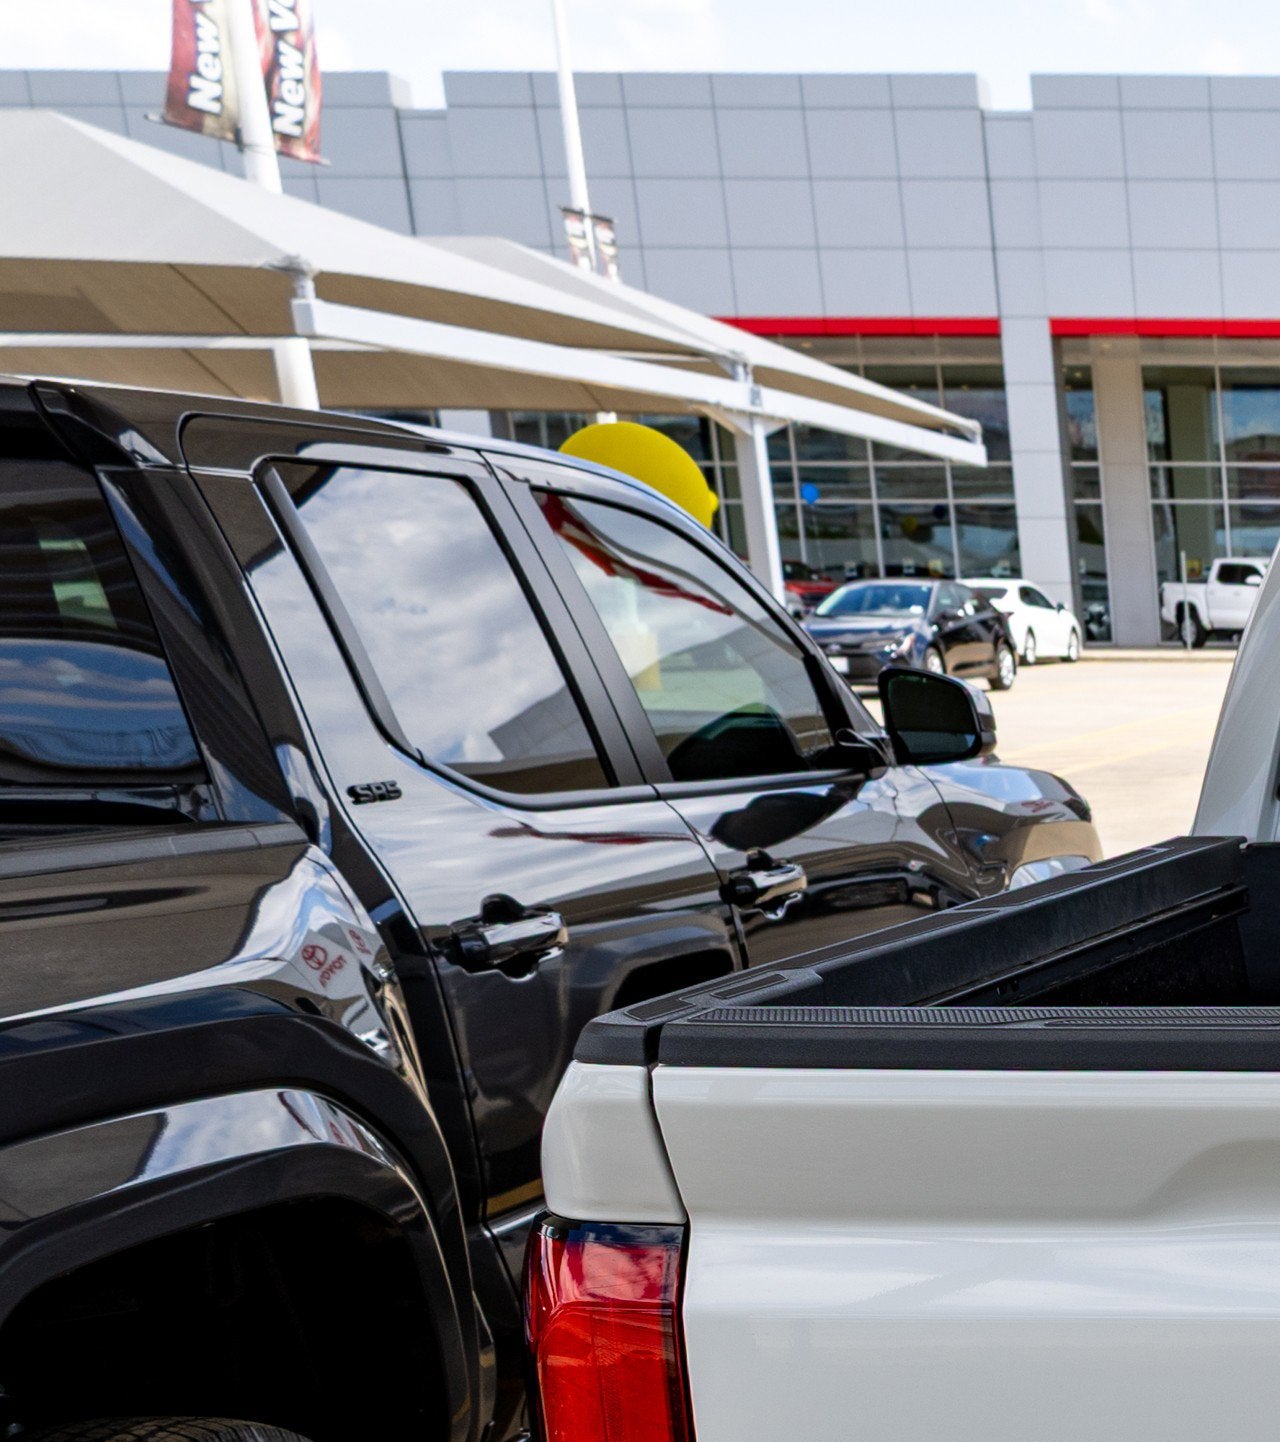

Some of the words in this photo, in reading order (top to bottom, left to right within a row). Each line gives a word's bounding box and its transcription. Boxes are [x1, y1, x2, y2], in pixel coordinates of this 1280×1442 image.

[188, 11, 223, 116] New
[272, 38, 305, 137] New
[349, 780, 401, 804] SR5
